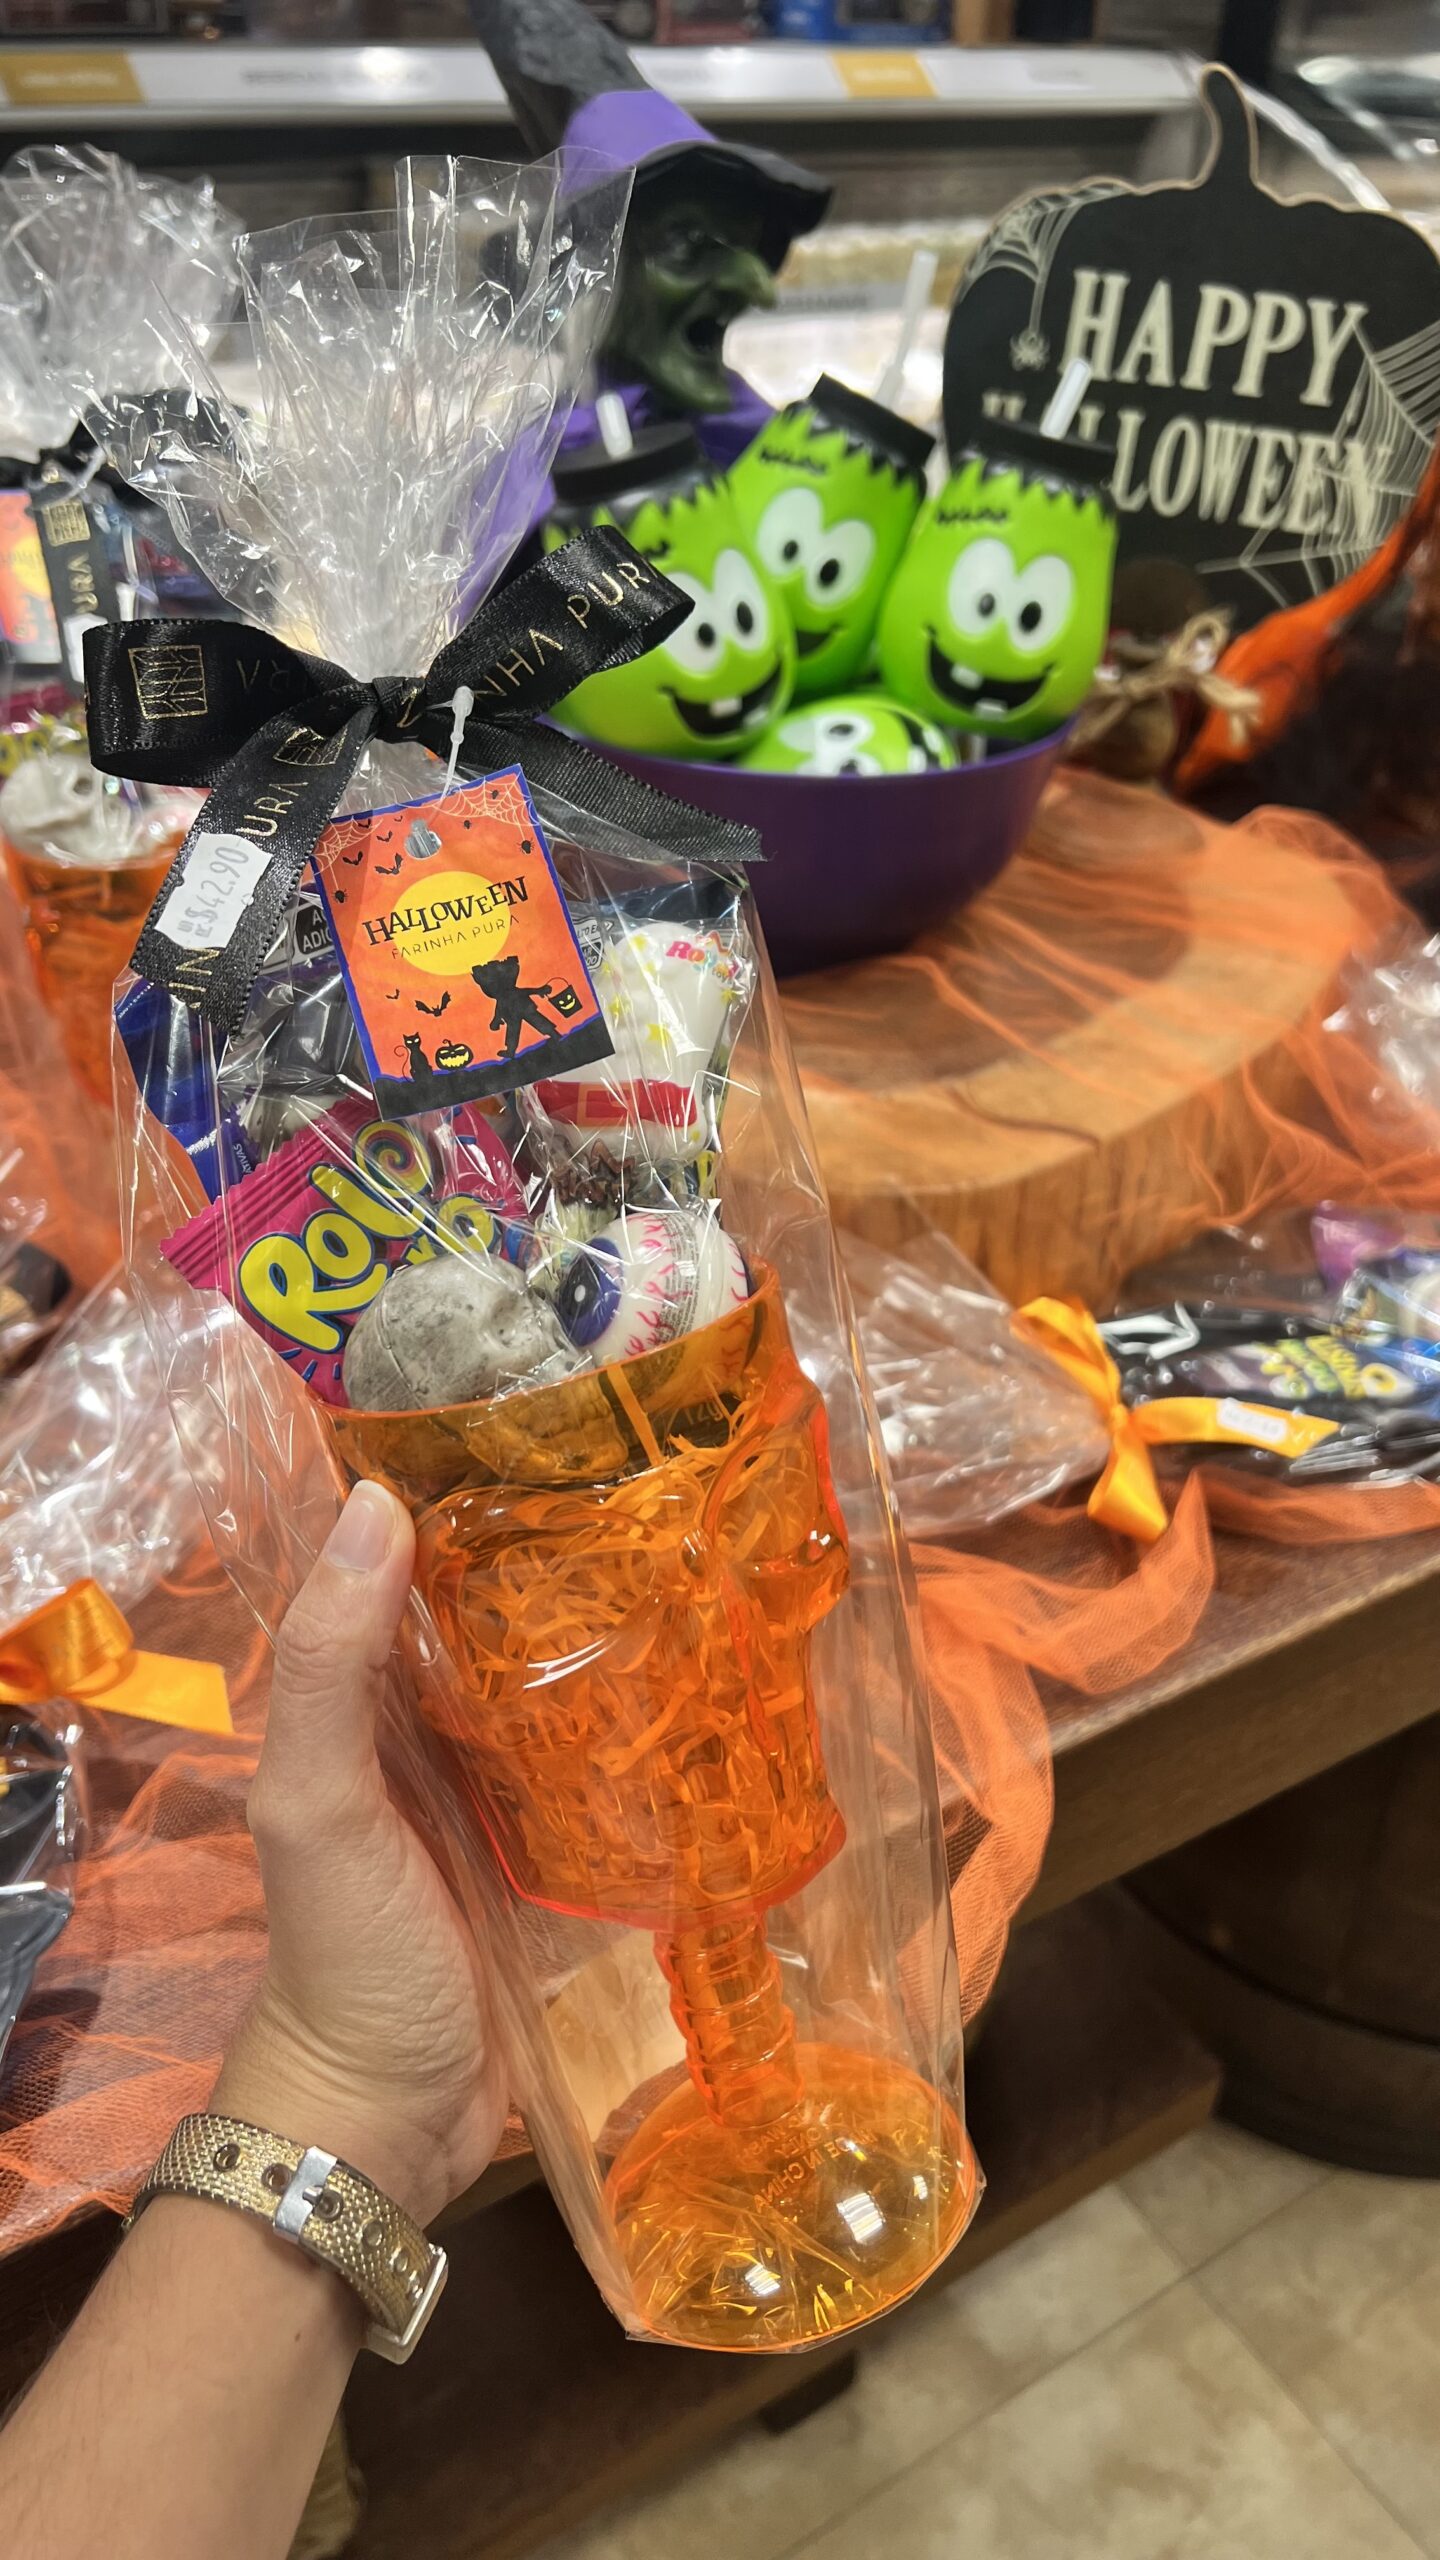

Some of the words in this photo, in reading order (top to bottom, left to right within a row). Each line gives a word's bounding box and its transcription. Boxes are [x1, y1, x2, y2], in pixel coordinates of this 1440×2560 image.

[1058, 265, 1369, 408] HAPPY
[981, 387, 1395, 546] LOWEEN
[566, 555, 660, 630] PUR
[362, 875, 529, 946] HALLOWEEN
[391, 931, 468, 960] FARINHA
[472, 914, 521, 938] PURA
